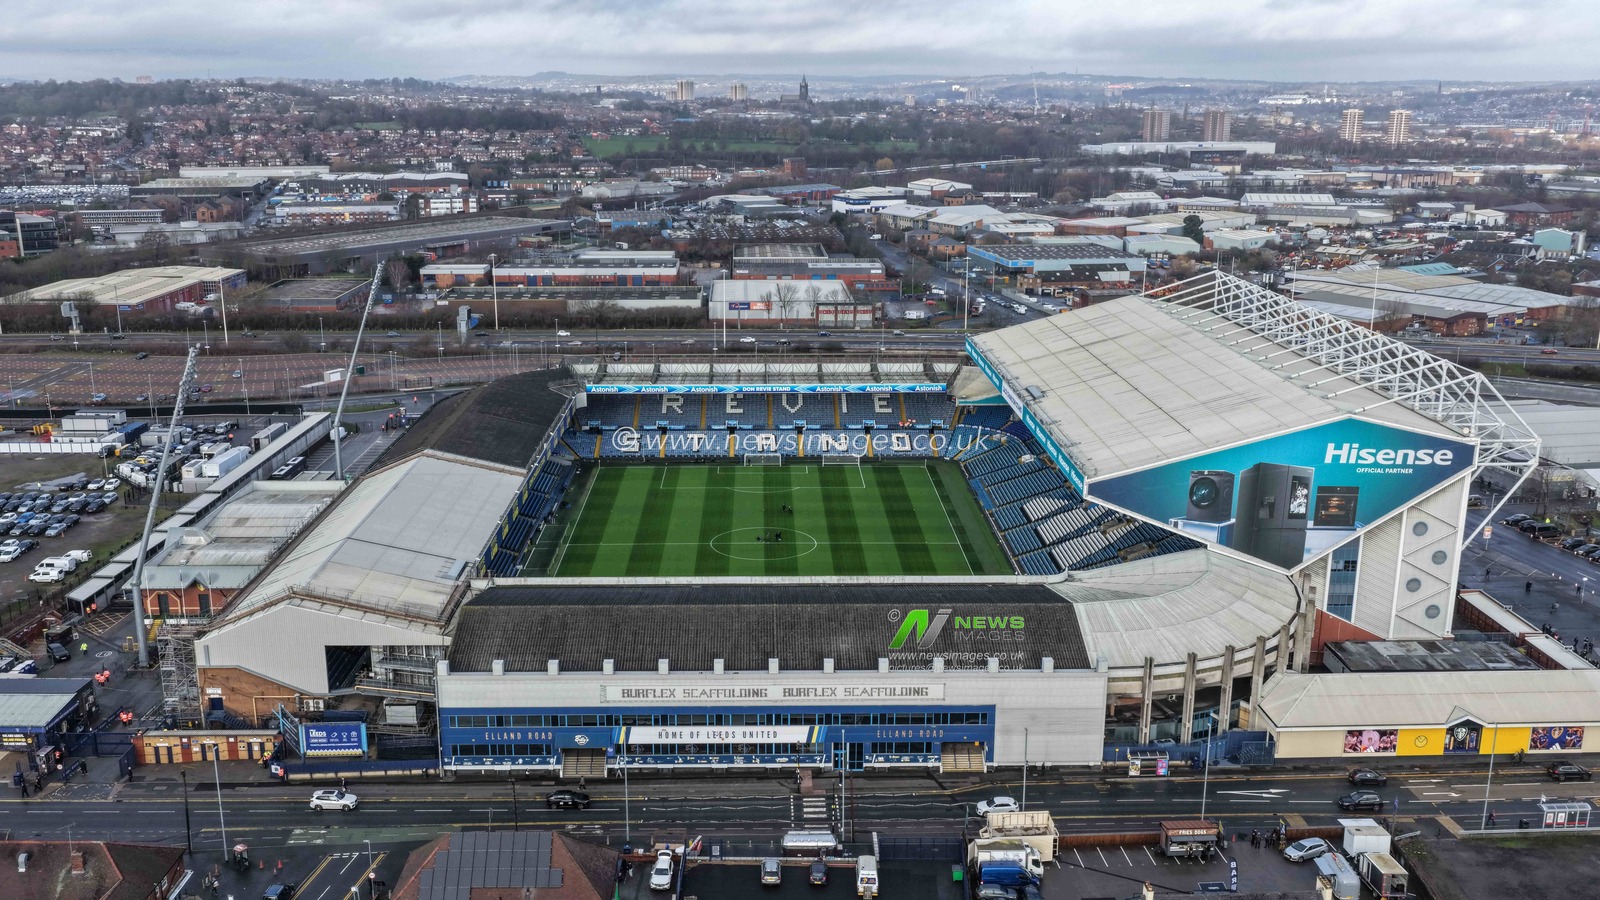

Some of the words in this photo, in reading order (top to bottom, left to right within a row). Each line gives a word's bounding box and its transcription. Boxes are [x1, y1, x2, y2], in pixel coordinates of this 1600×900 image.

[815, 385, 843, 393] Astonish
[1324, 443, 1453, 465] Hisense
[622, 688, 676, 698] BURFLEX
[683, 688, 768, 698] SCAFFOLDING
[783, 687, 837, 698] BURFLEX
[844, 687, 929, 698] SCAFFOLDING
[485, 731, 521, 740] ELLAND
[528, 731, 553, 740] ROAD
[658, 731, 683, 739] HOME
[689, 731, 700, 739] OF
[706, 731, 736, 739] LEEDS
[742, 730, 778, 738] UNITED
[877, 730, 912, 738] ELLAND
[919, 730, 944, 738] ROAD
